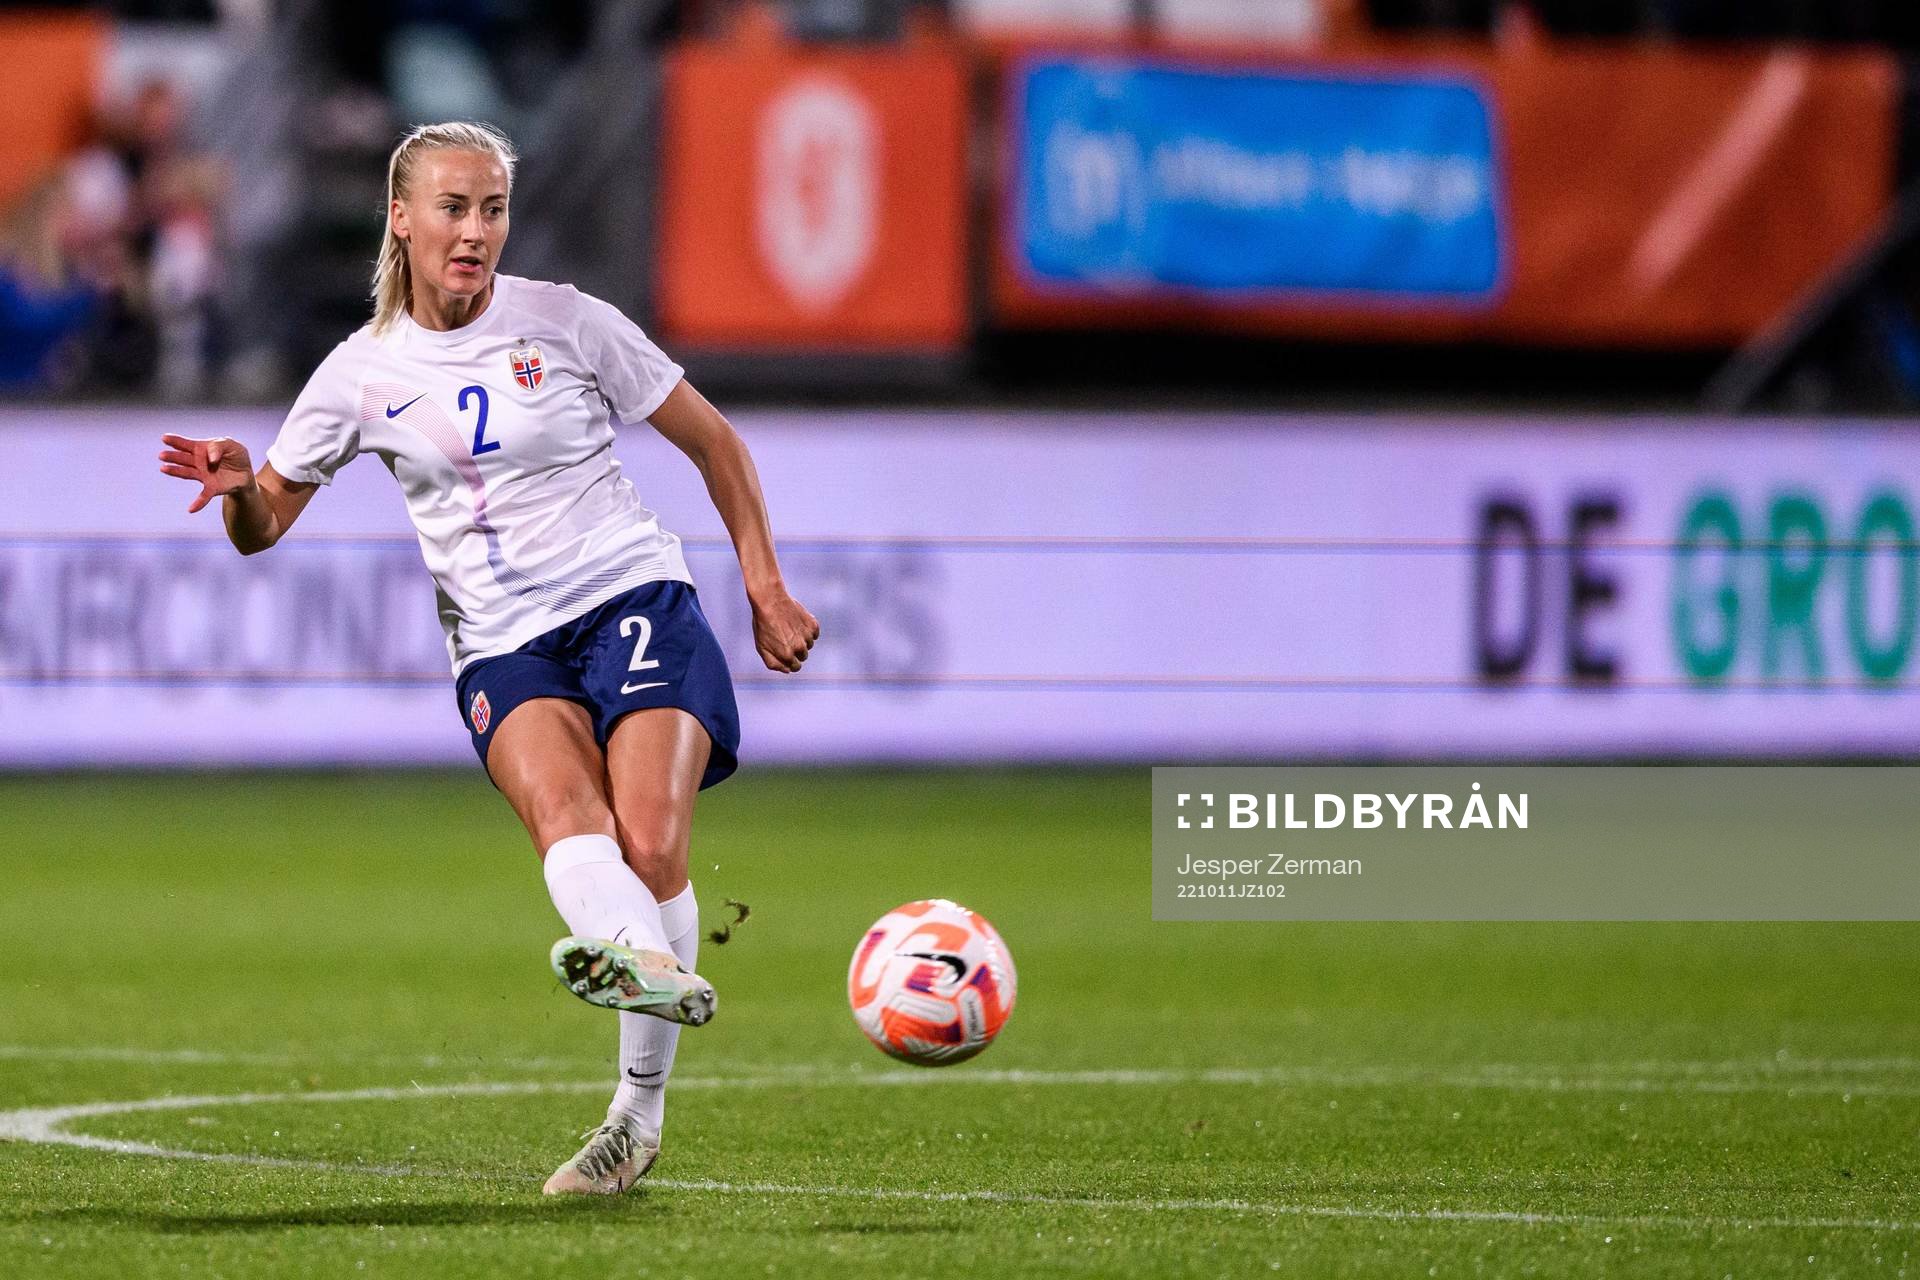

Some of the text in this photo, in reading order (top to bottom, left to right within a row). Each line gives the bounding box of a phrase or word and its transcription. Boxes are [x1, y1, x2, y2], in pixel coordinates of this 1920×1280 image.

[458, 385, 501, 457] 2
[1472, 486, 1920, 690] DE GRO
[619, 615, 660, 672] 2
